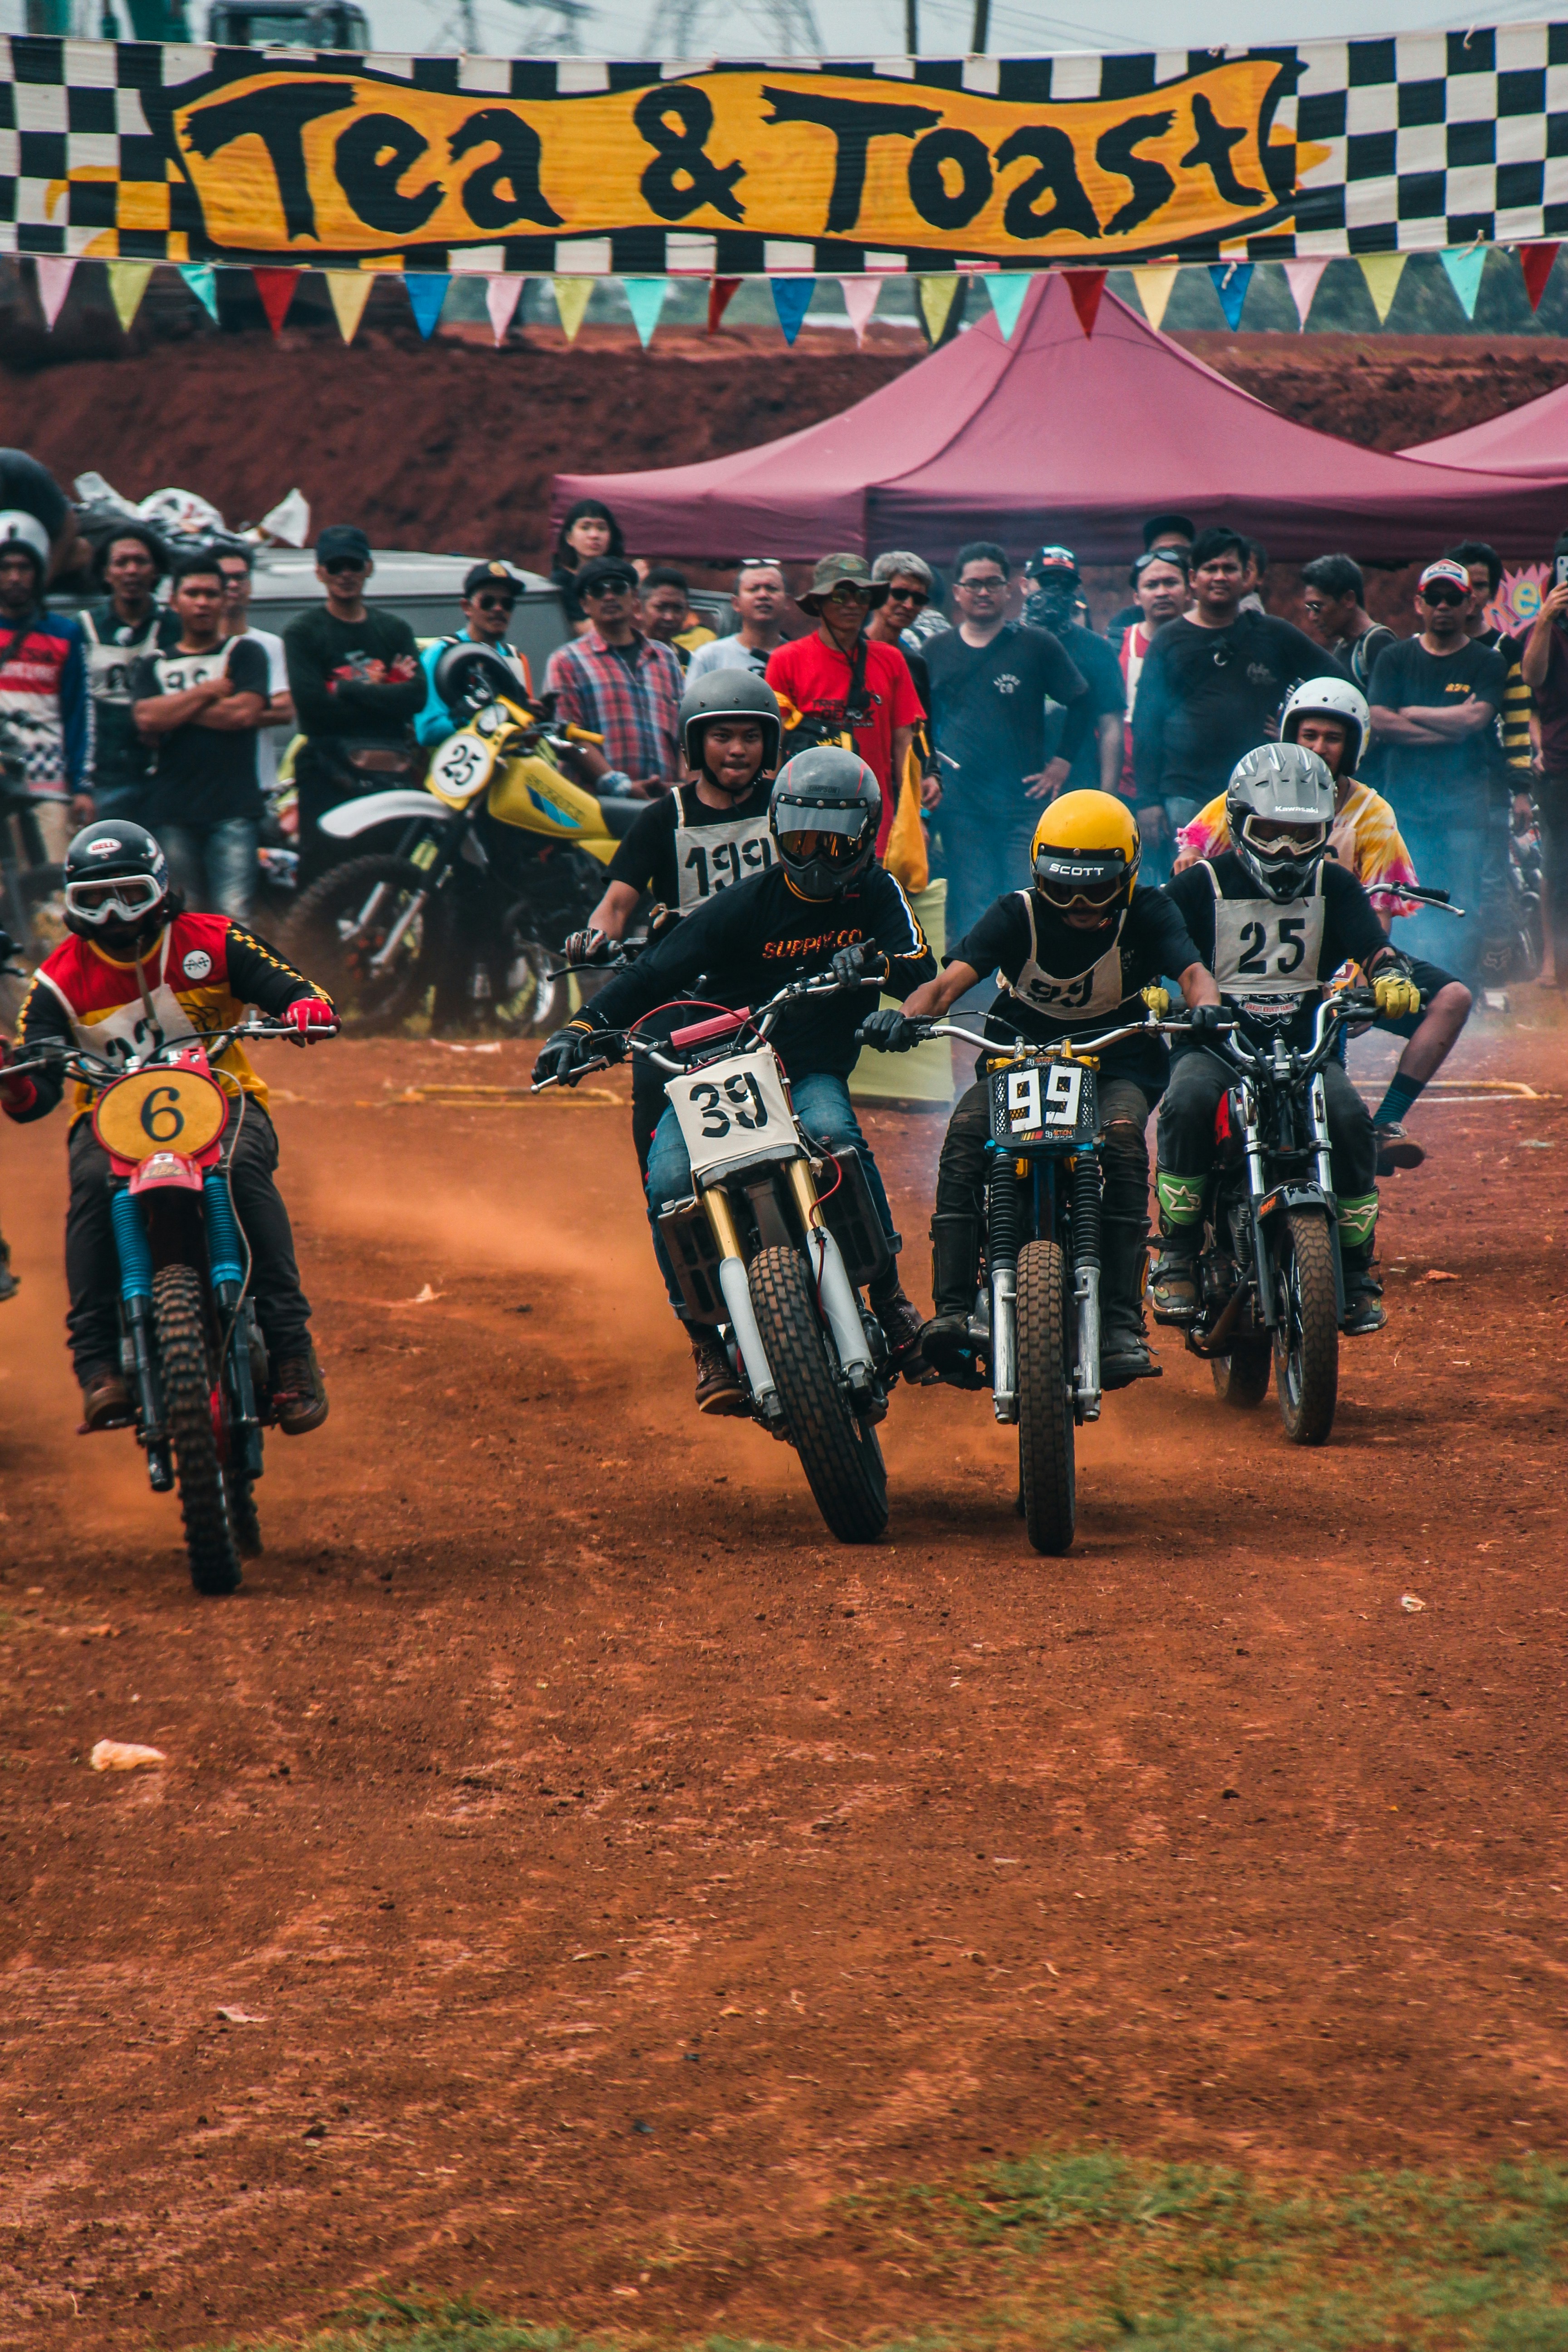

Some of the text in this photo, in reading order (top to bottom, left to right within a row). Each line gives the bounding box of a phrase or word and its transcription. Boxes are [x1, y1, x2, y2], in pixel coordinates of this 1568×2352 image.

[181, 81, 1271, 242] Tea & Toast
[441, 744, 481, 785] 25
[1275, 805, 1319, 813] Kawasaki
[92, 842, 114, 851] BELL
[685, 838, 772, 897] 199
[1049, 863, 1104, 876] SCOTT
[1238, 917, 1306, 974] 25
[140, 1086, 184, 1142] 6
[690, 1072, 768, 1138] 39
[1009, 1065, 1083, 1133] 99
